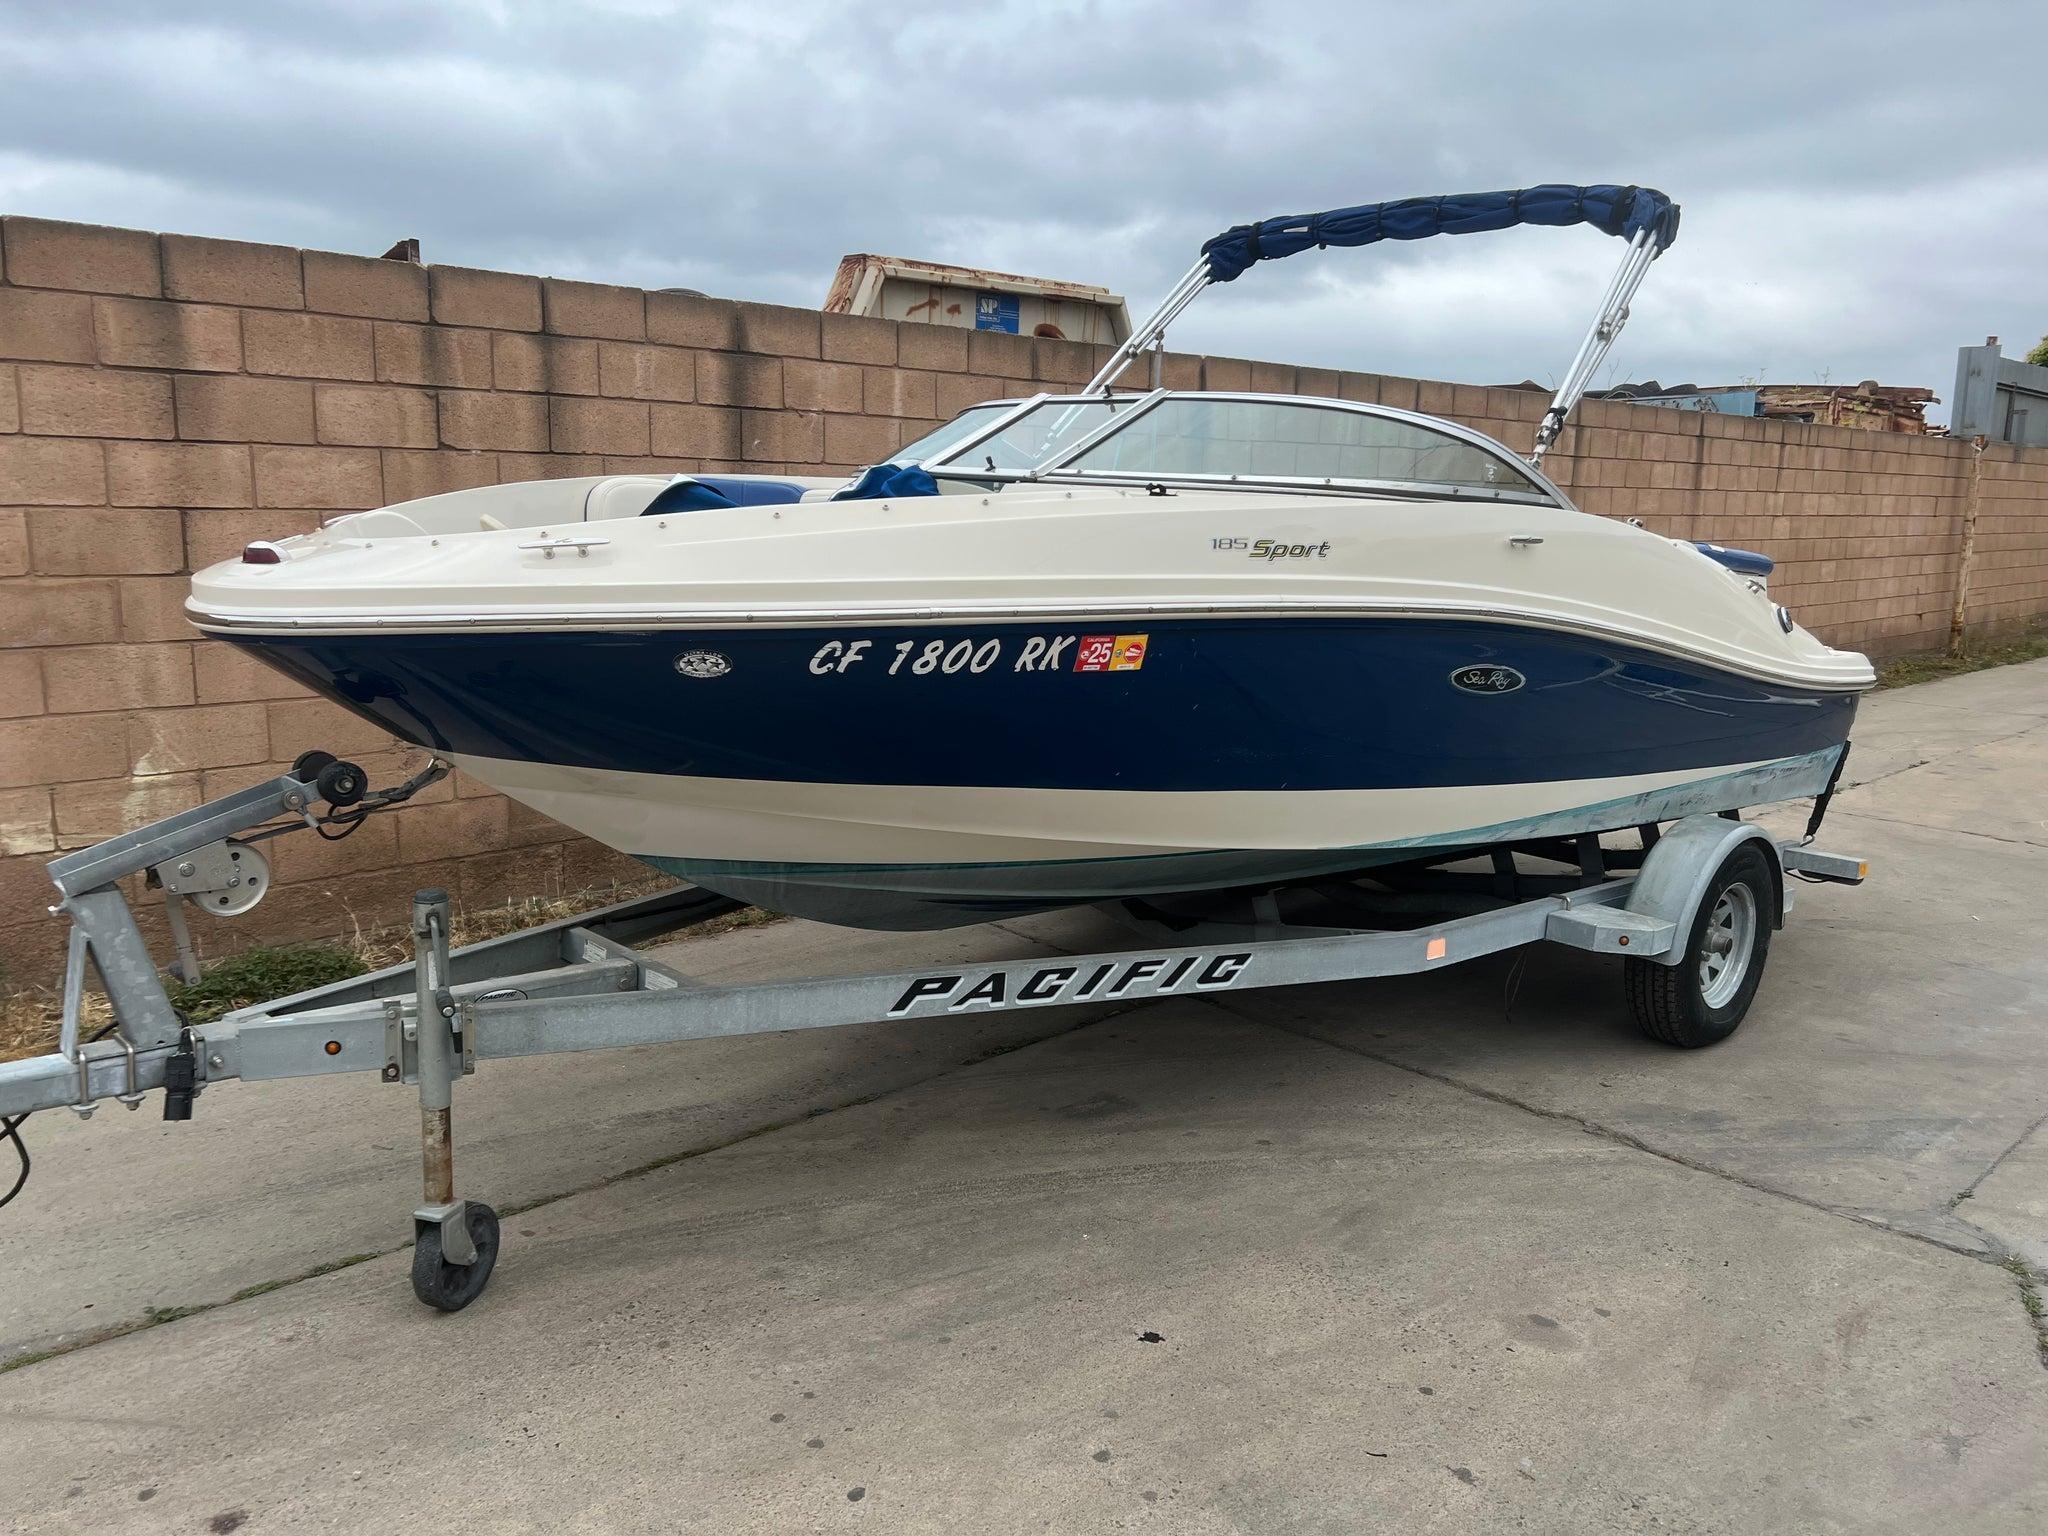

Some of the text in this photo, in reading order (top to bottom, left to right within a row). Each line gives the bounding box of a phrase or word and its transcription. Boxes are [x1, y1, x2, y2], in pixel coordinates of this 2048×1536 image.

[1211, 538, 1331, 562] 185 Sport
[808, 635, 1076, 676] CF 1800 RK
[1087, 642, 1113, 664] 25
[1463, 670, 1512, 690] Sea Ray
[886, 952, 1253, 1018] PACIFIC
